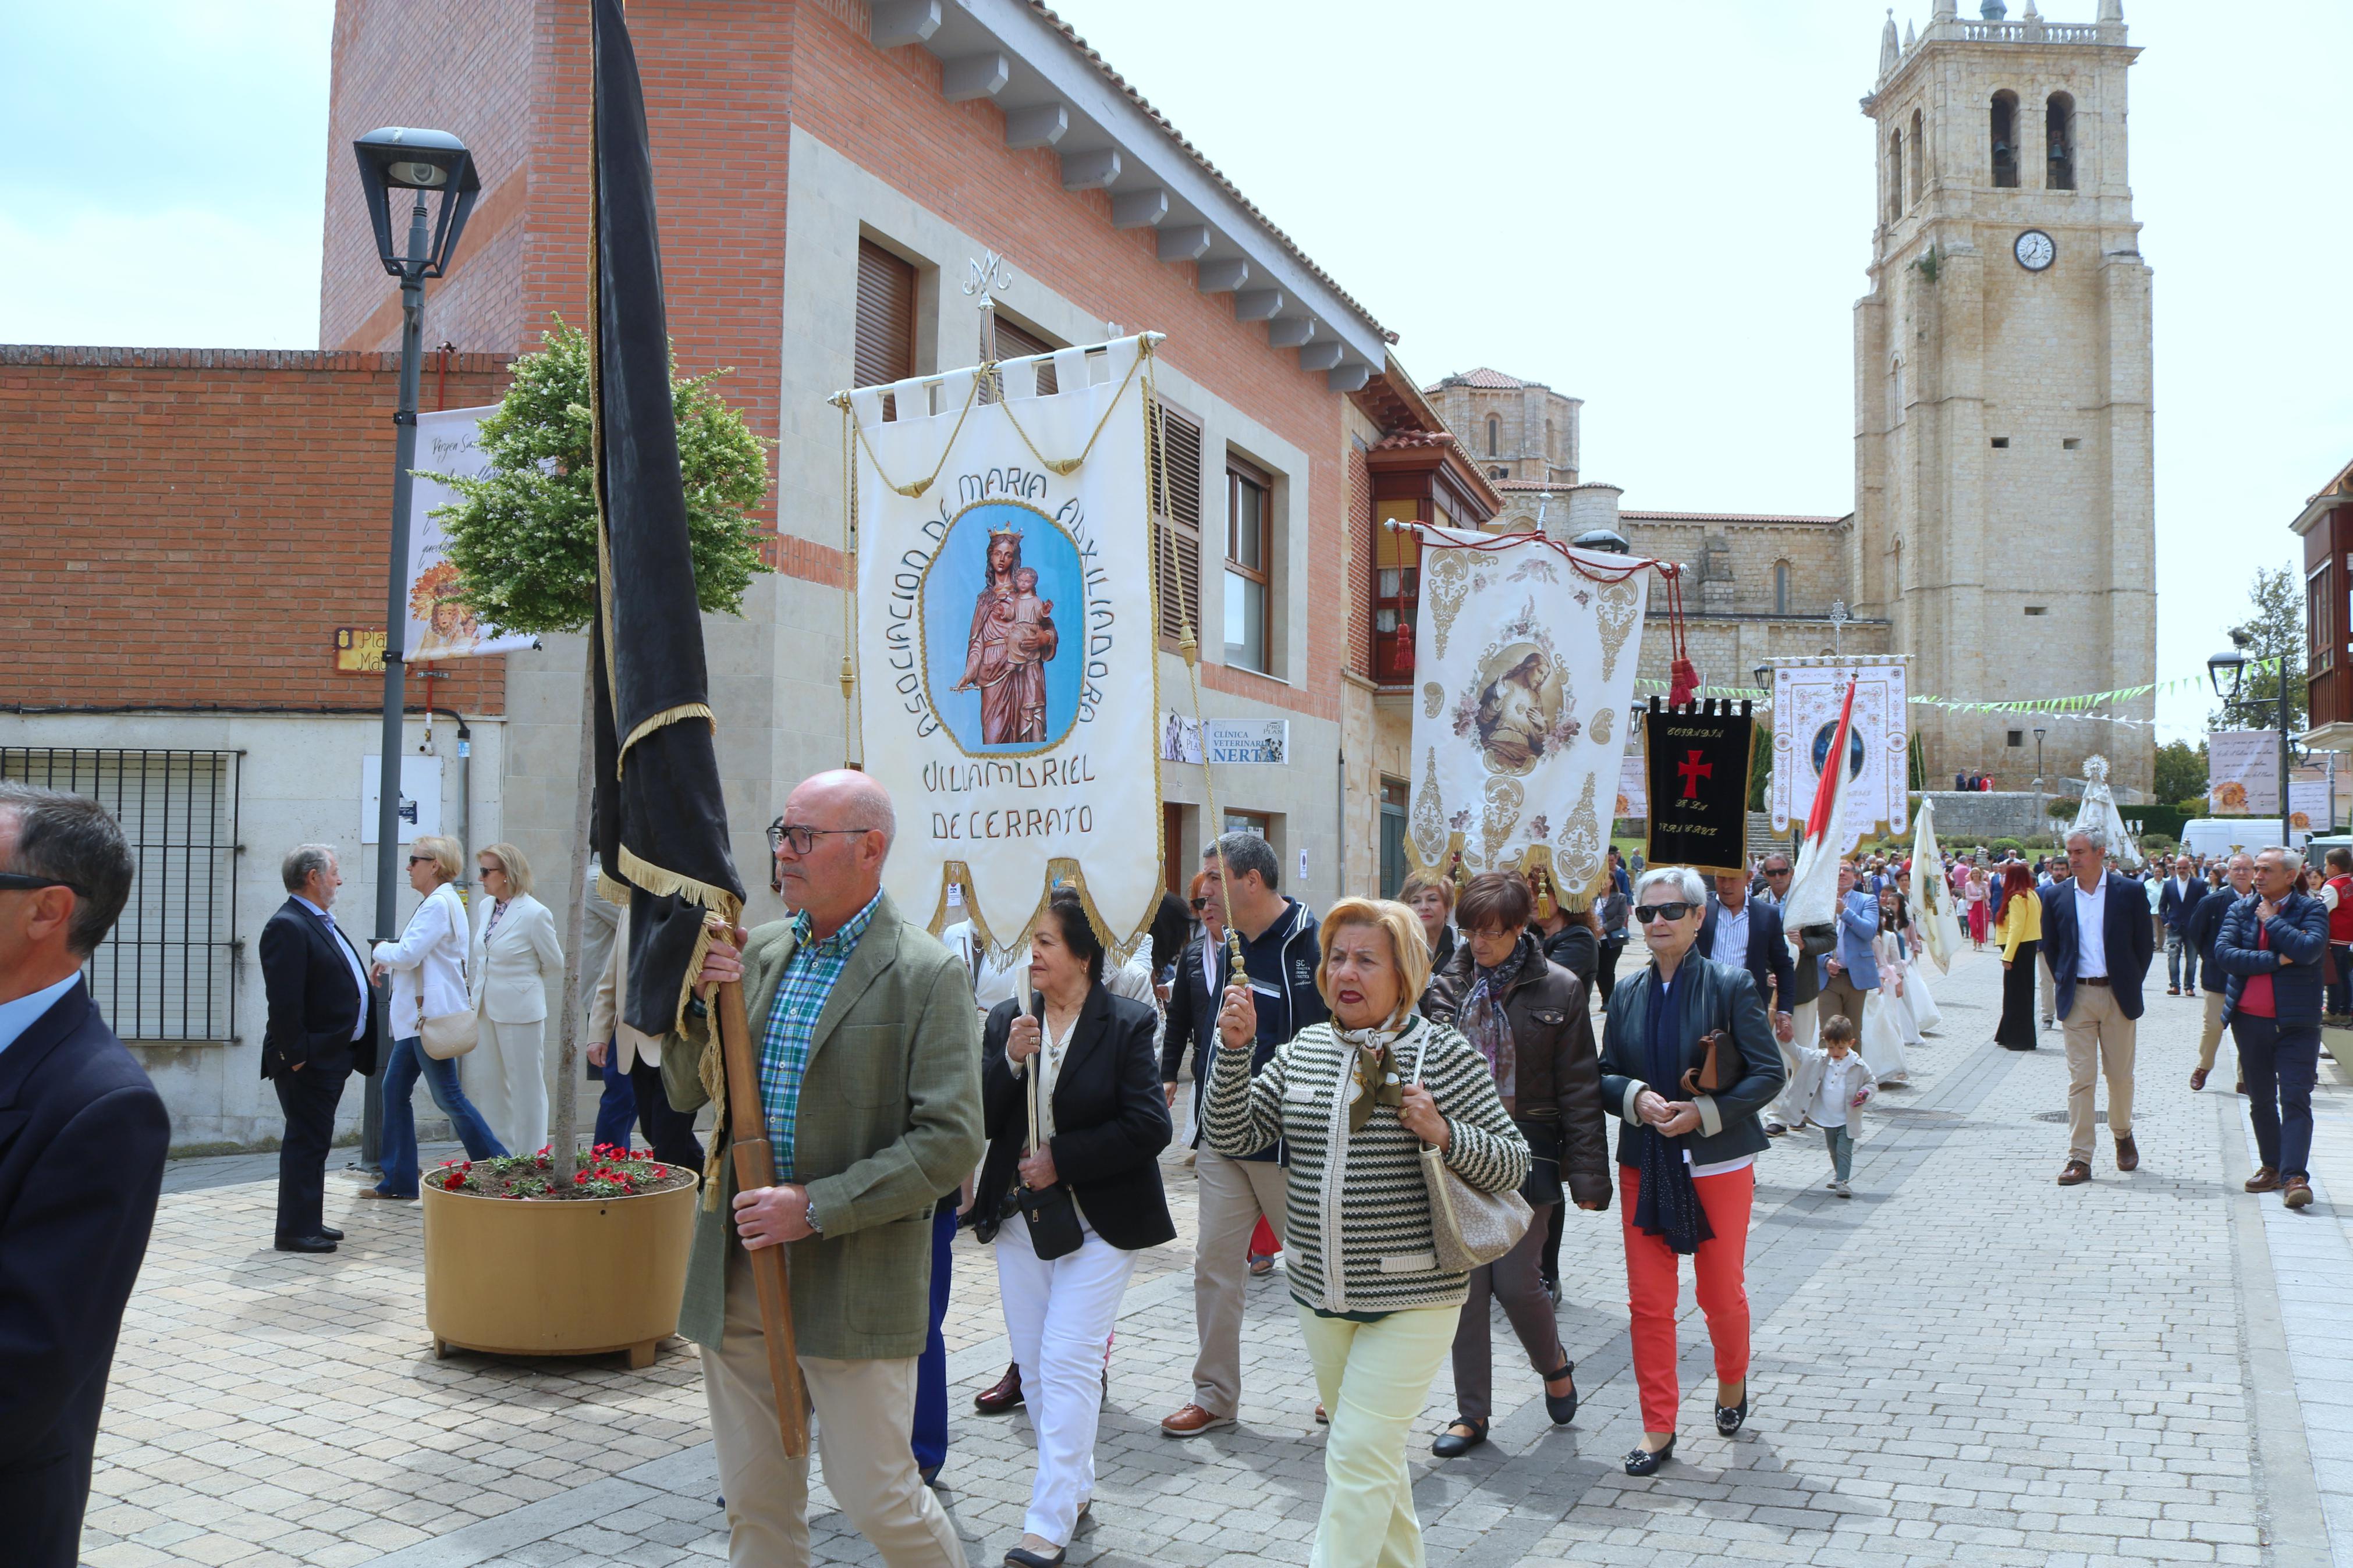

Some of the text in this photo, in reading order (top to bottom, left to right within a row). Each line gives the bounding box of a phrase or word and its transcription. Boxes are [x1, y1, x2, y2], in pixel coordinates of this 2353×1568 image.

[432, 436, 458, 464] Virgen
[921, 496, 952, 542] DE
[959, 467, 1046, 505] MARIA
[1056, 497, 1115, 723] AUXILIADORA
[359, 630, 386, 649] Pla
[1214, 730, 1248, 738] CLÍNICA
[1213, 748, 1275, 762] NERTA
[922, 753, 1095, 792] VILLAMURIEL
[932, 805, 1092, 839] DE CERRATO
